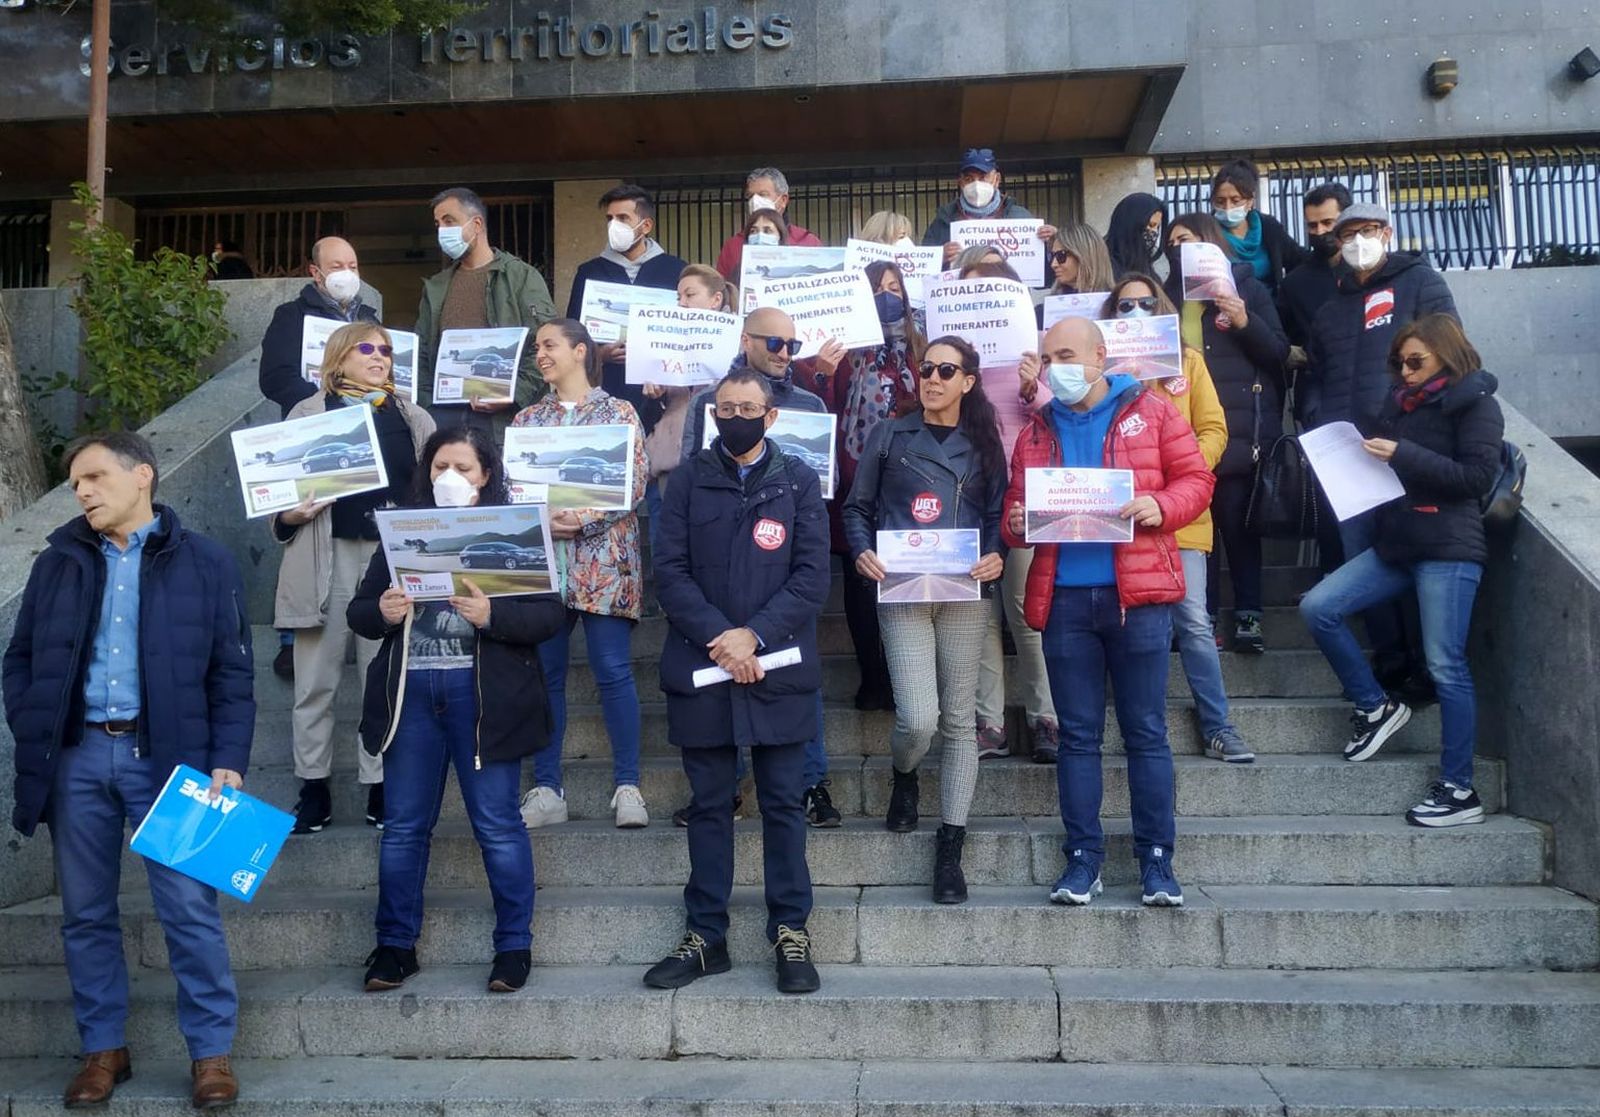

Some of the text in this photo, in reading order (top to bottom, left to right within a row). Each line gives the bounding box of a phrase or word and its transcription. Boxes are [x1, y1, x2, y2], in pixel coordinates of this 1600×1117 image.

[778, 288, 855, 307] KILOMETRAJE
[791, 305, 852, 322] TINERANTES
[938, 299, 1016, 314] KILOMETRAJE
[942, 319, 1009, 332] ITINERANTES
[1366, 313, 1394, 330] CGT
[647, 324, 722, 336] KILOMETRAJE
[650, 341, 713, 353] ITINERANTES
[661, 359, 683, 374] YA
[1118, 412, 1141, 433] UGT
[1048, 487, 1090, 495] AUMENTO
[915, 498, 938, 511] UGT
[756, 521, 783, 537] UGT
